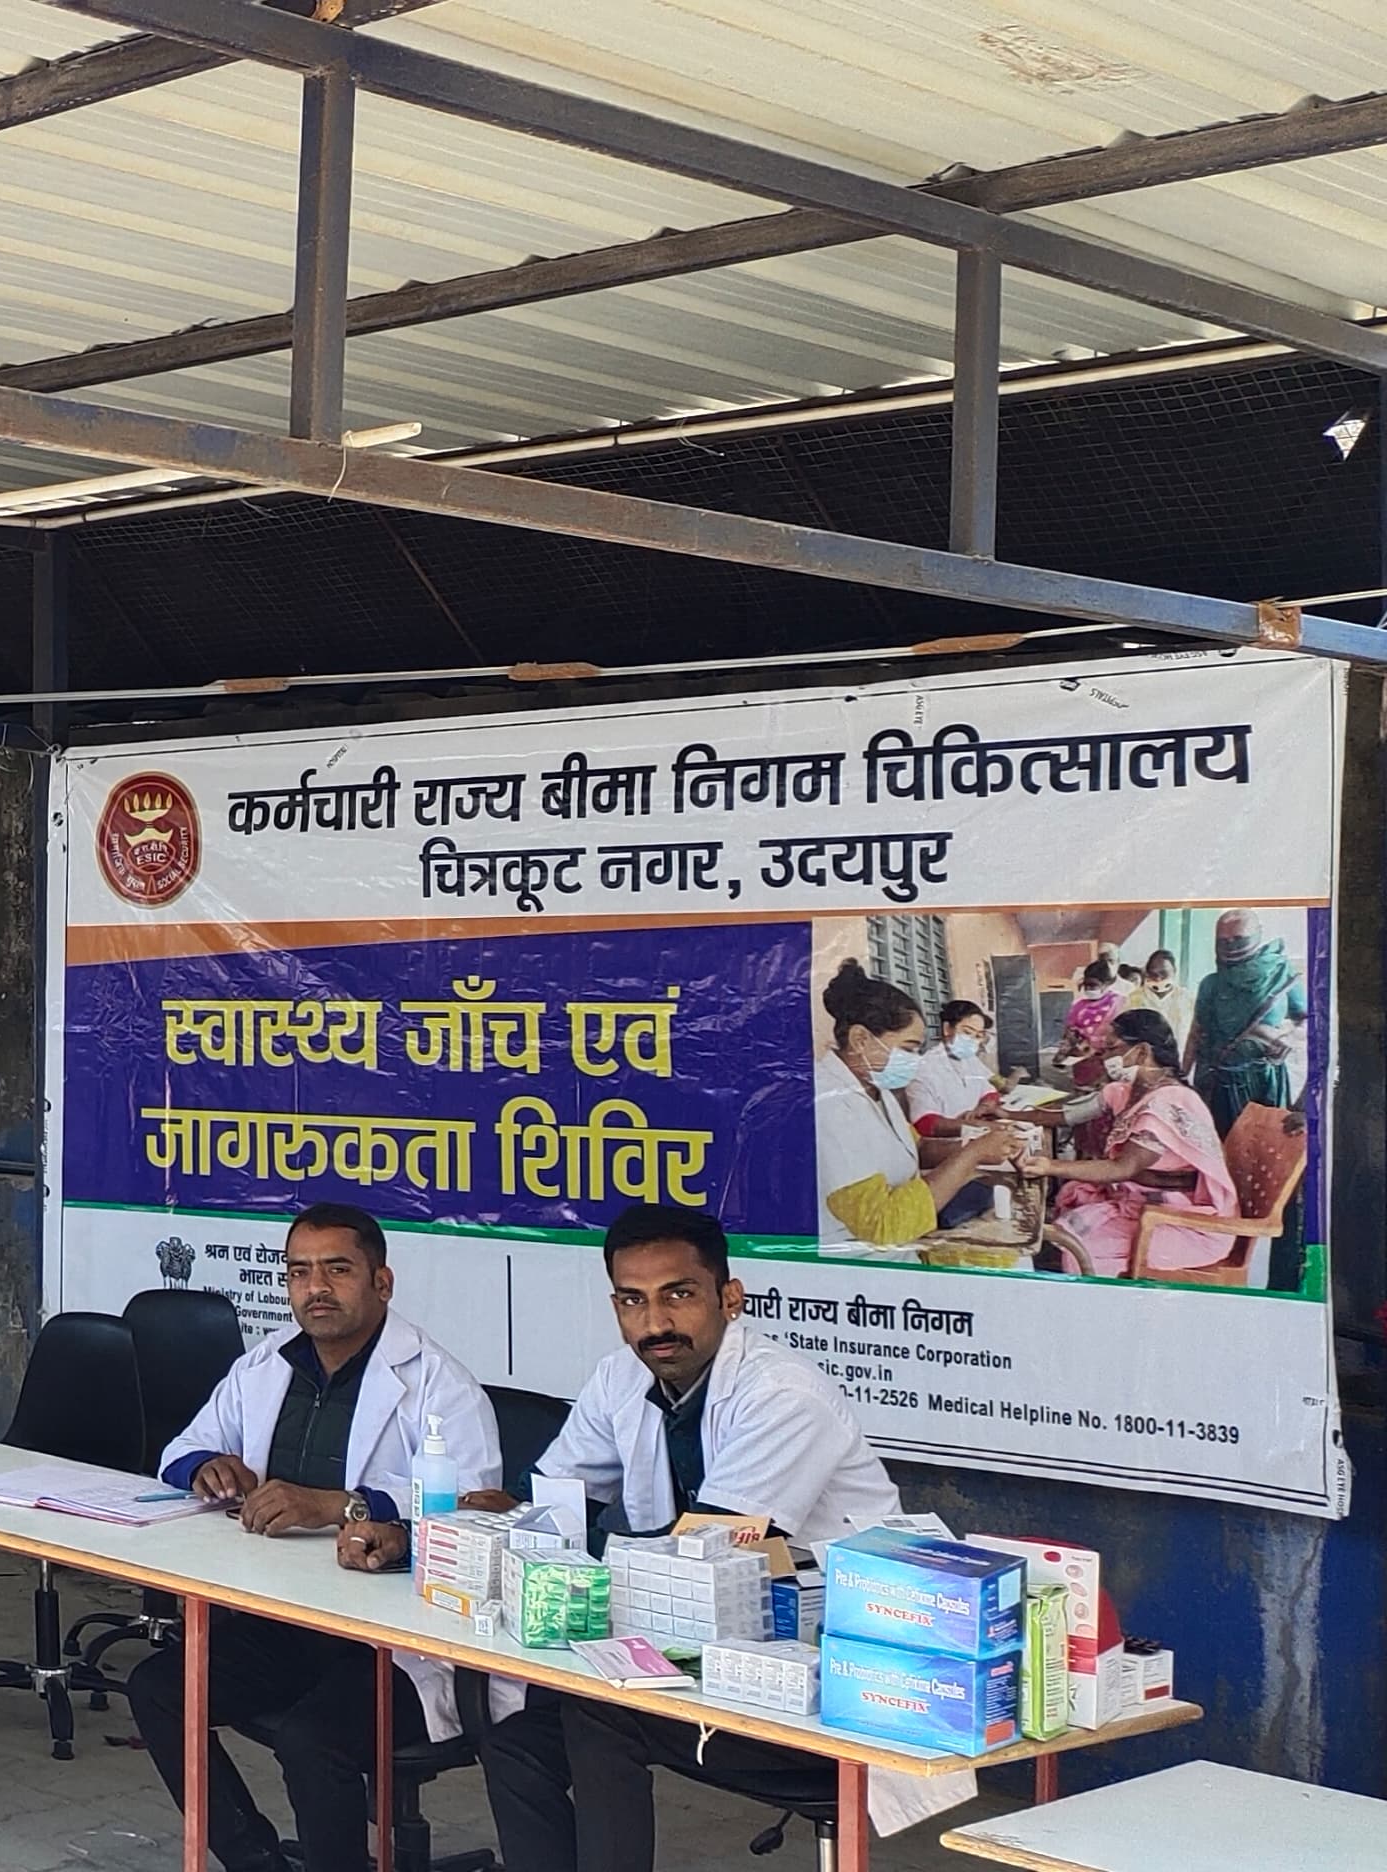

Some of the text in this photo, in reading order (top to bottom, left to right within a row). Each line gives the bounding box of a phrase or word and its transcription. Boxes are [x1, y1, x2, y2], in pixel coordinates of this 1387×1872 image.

[228, 723, 1253, 835] कर्मचारी राज्य बीमा निगम चिकित्सालय
[136, 852, 167, 866] ESIC
[420, 832, 953, 913] चित्रकूट नगर, उदयपुर
[162, 975, 680, 1078] स्वास्थ्य जाँच एवं
[494, 1095, 715, 1207] शिविर
[239, 1267, 273, 1287] भारत
[244, 1289, 255, 1303] of
[788, 1293, 839, 1326] राज्य
[846, 1294, 896, 1331] बीमा
[902, 1297, 974, 1338] निगम
[833, 1334, 910, 1360] Insurance
[915, 1341, 1012, 1371] Corporation
[927, 1392, 994, 1418] Medical
[1000, 1401, 1073, 1428] Helpline
[1078, 1409, 1108, 1430] No.
[1113, 1414, 1240, 1445] 1800-11-3839
[865, 1602, 933, 1627] SYNCEFIX
[861, 1691, 930, 1714] SYNCEFIX
